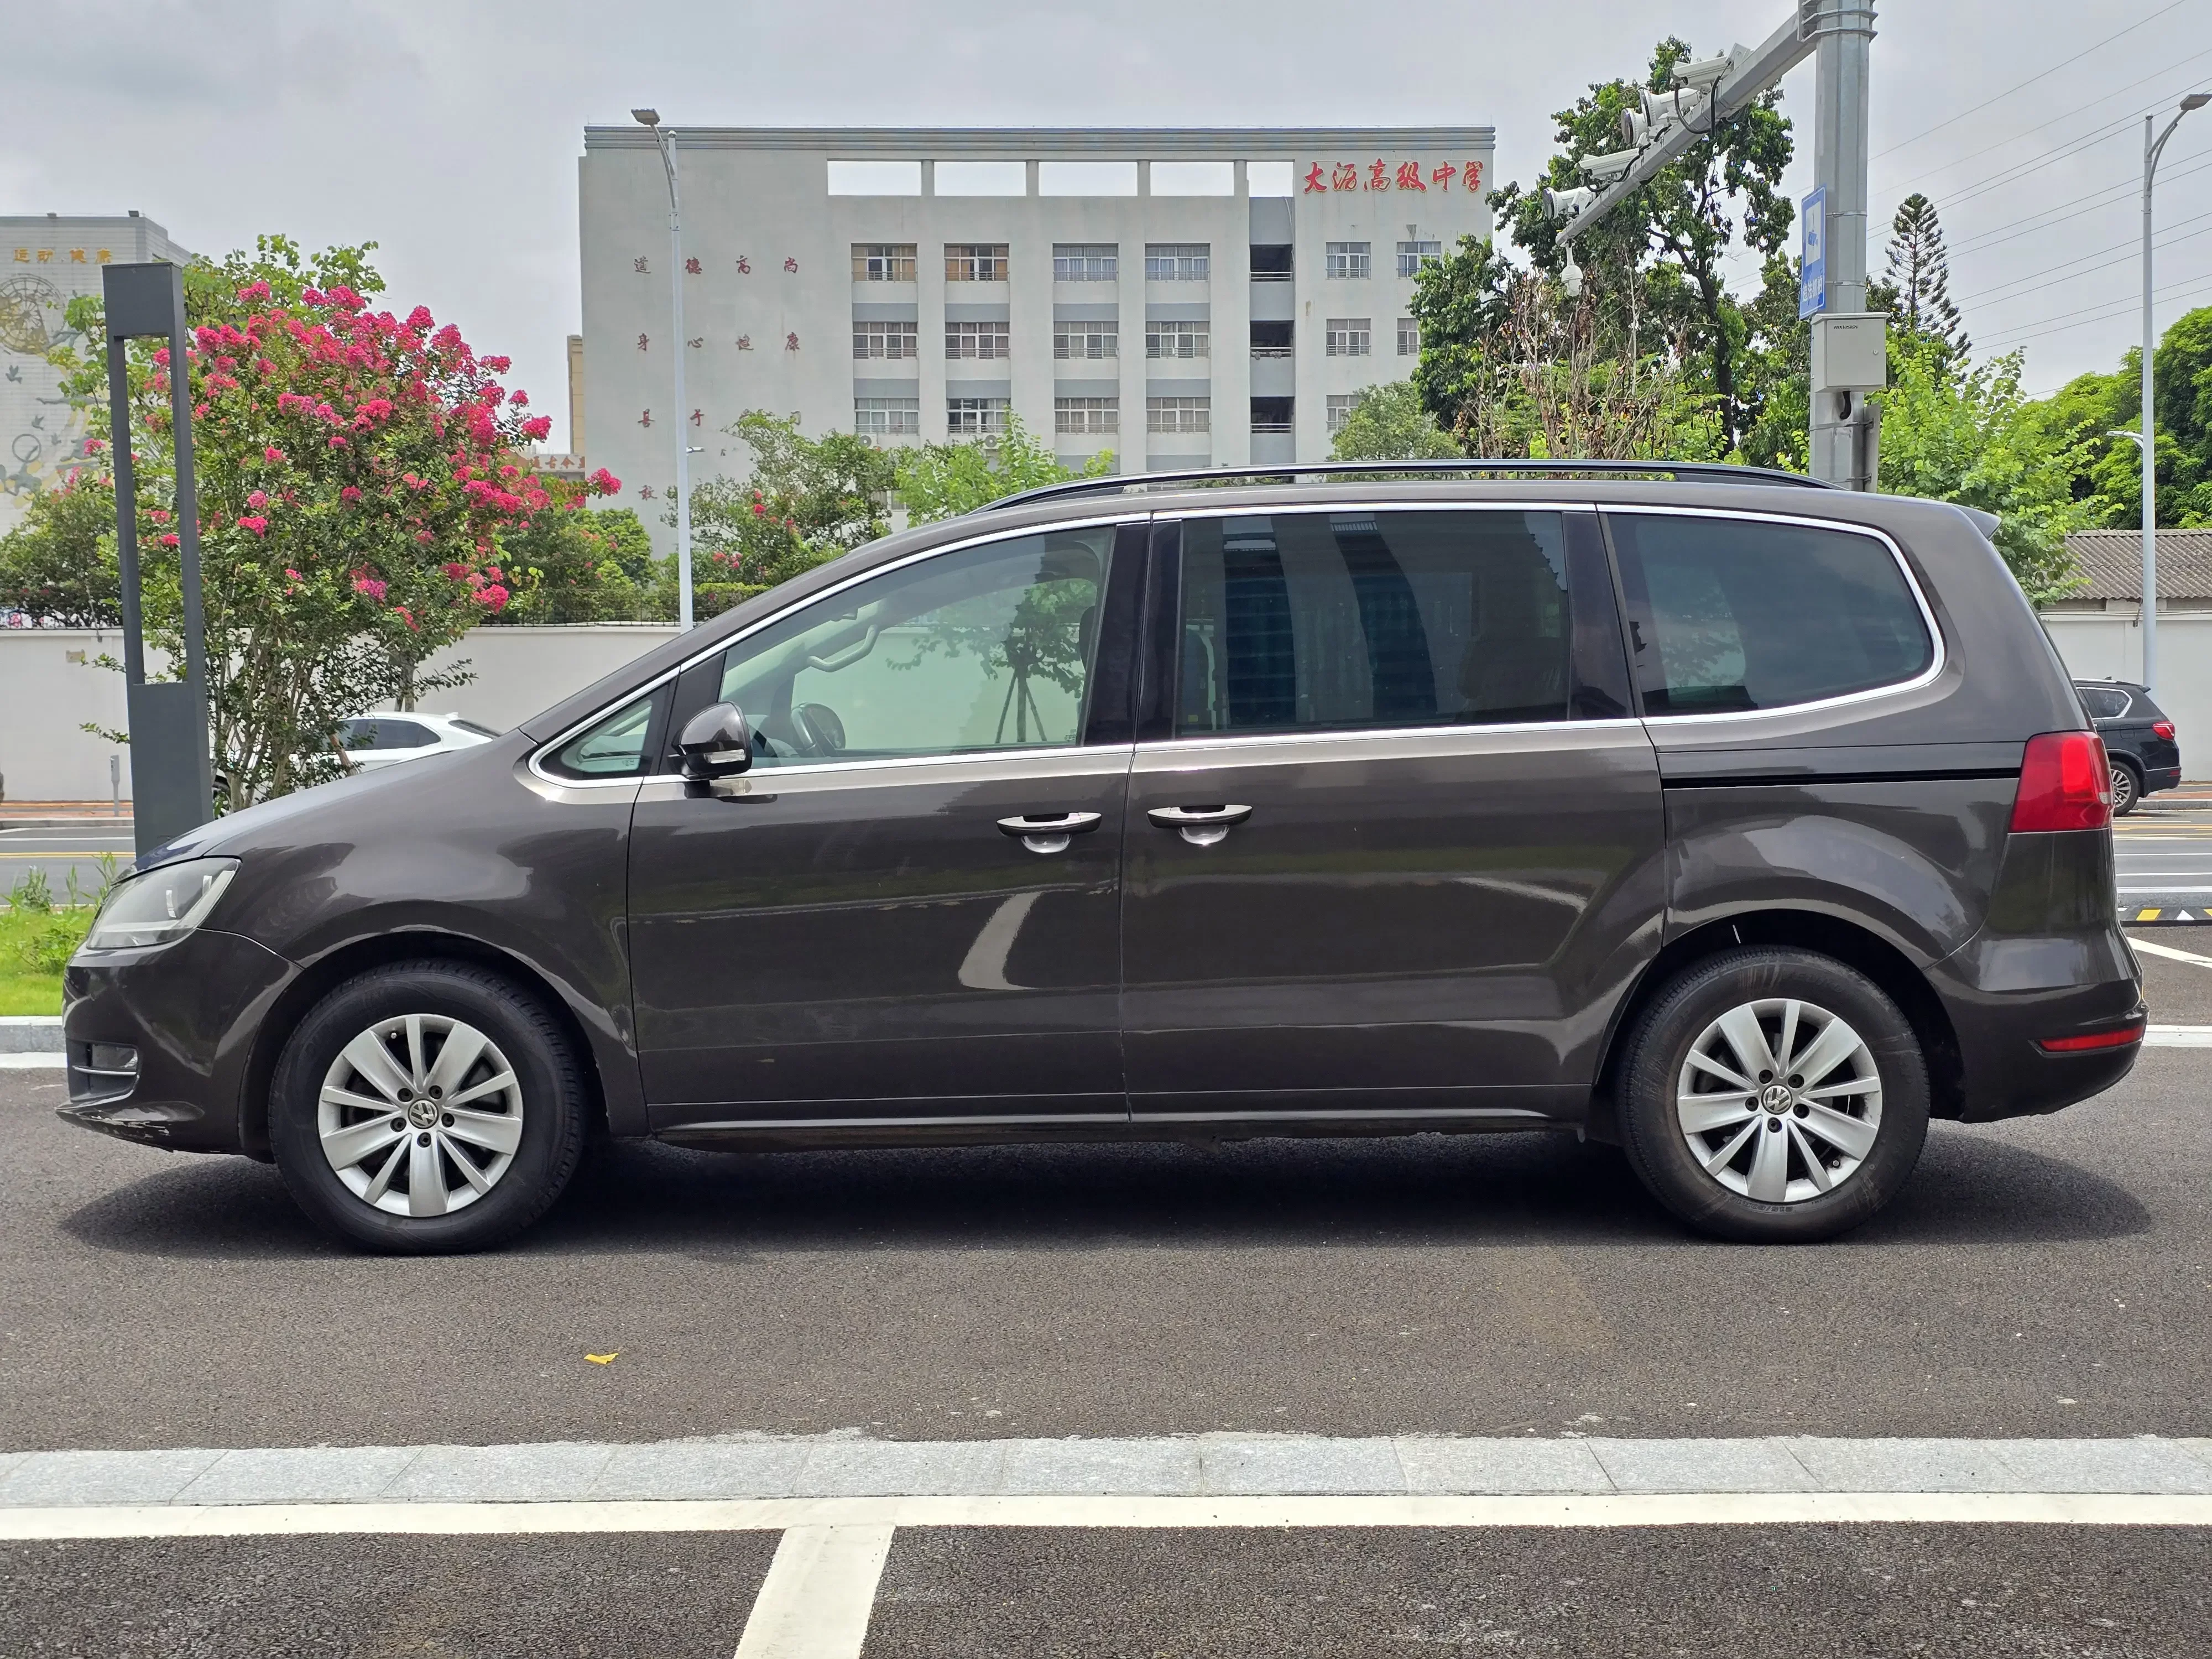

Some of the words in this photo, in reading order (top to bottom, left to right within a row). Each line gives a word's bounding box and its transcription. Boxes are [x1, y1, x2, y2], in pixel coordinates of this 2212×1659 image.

[1303, 158, 1484, 193] 大沥高级中学
